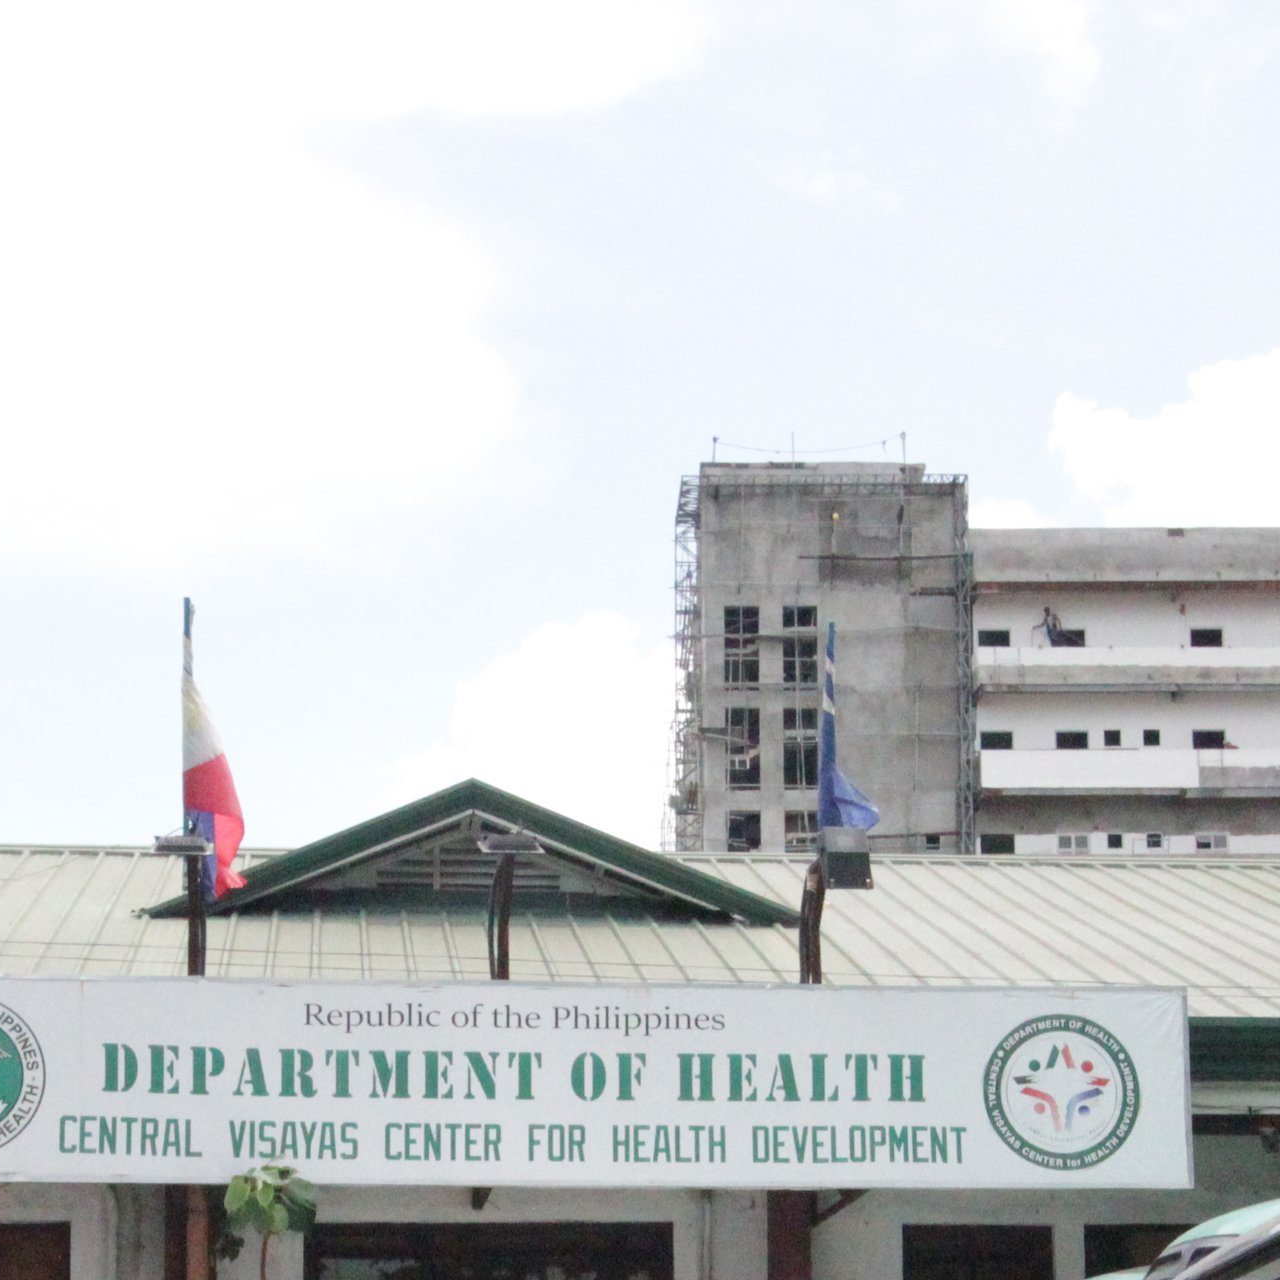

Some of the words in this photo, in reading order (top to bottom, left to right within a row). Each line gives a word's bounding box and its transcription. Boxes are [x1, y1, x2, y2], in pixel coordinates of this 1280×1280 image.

[304, 1002, 441, 1034] Republic
[451, 1003, 484, 1028] of
[492, 1004, 541, 1029] the
[552, 1005, 726, 1037] Philippines
[1002, 1018, 1066, 1051] DEPARTMENT
[1068, 1019, 1083, 1030] OF
[1084, 1024, 1120, 1053] HEALTH
[102, 1043, 545, 1099] DEPARTMENT
[570, 1052, 646, 1101] OF
[679, 1053, 926, 1102] HEALTH
[987, 1058, 1002, 1107] CENTRAL
[1116, 1060, 1136, 1138] DEVELOPMENT
[58, 1115, 203, 1157] CENTRAL
[229, 1121, 359, 1161] VISAYAS
[384, 1123, 501, 1161] CENTER
[528, 1123, 585, 1162] FOR
[612, 1125, 727, 1163] HEALTH
[752, 1124, 967, 1164] DEVELOPMENT
[991, 1109, 1021, 1150] VISAYAS
[1021, 1147, 1064, 1168] CENTER
[1083, 1137, 1120, 1165] HEALTH
